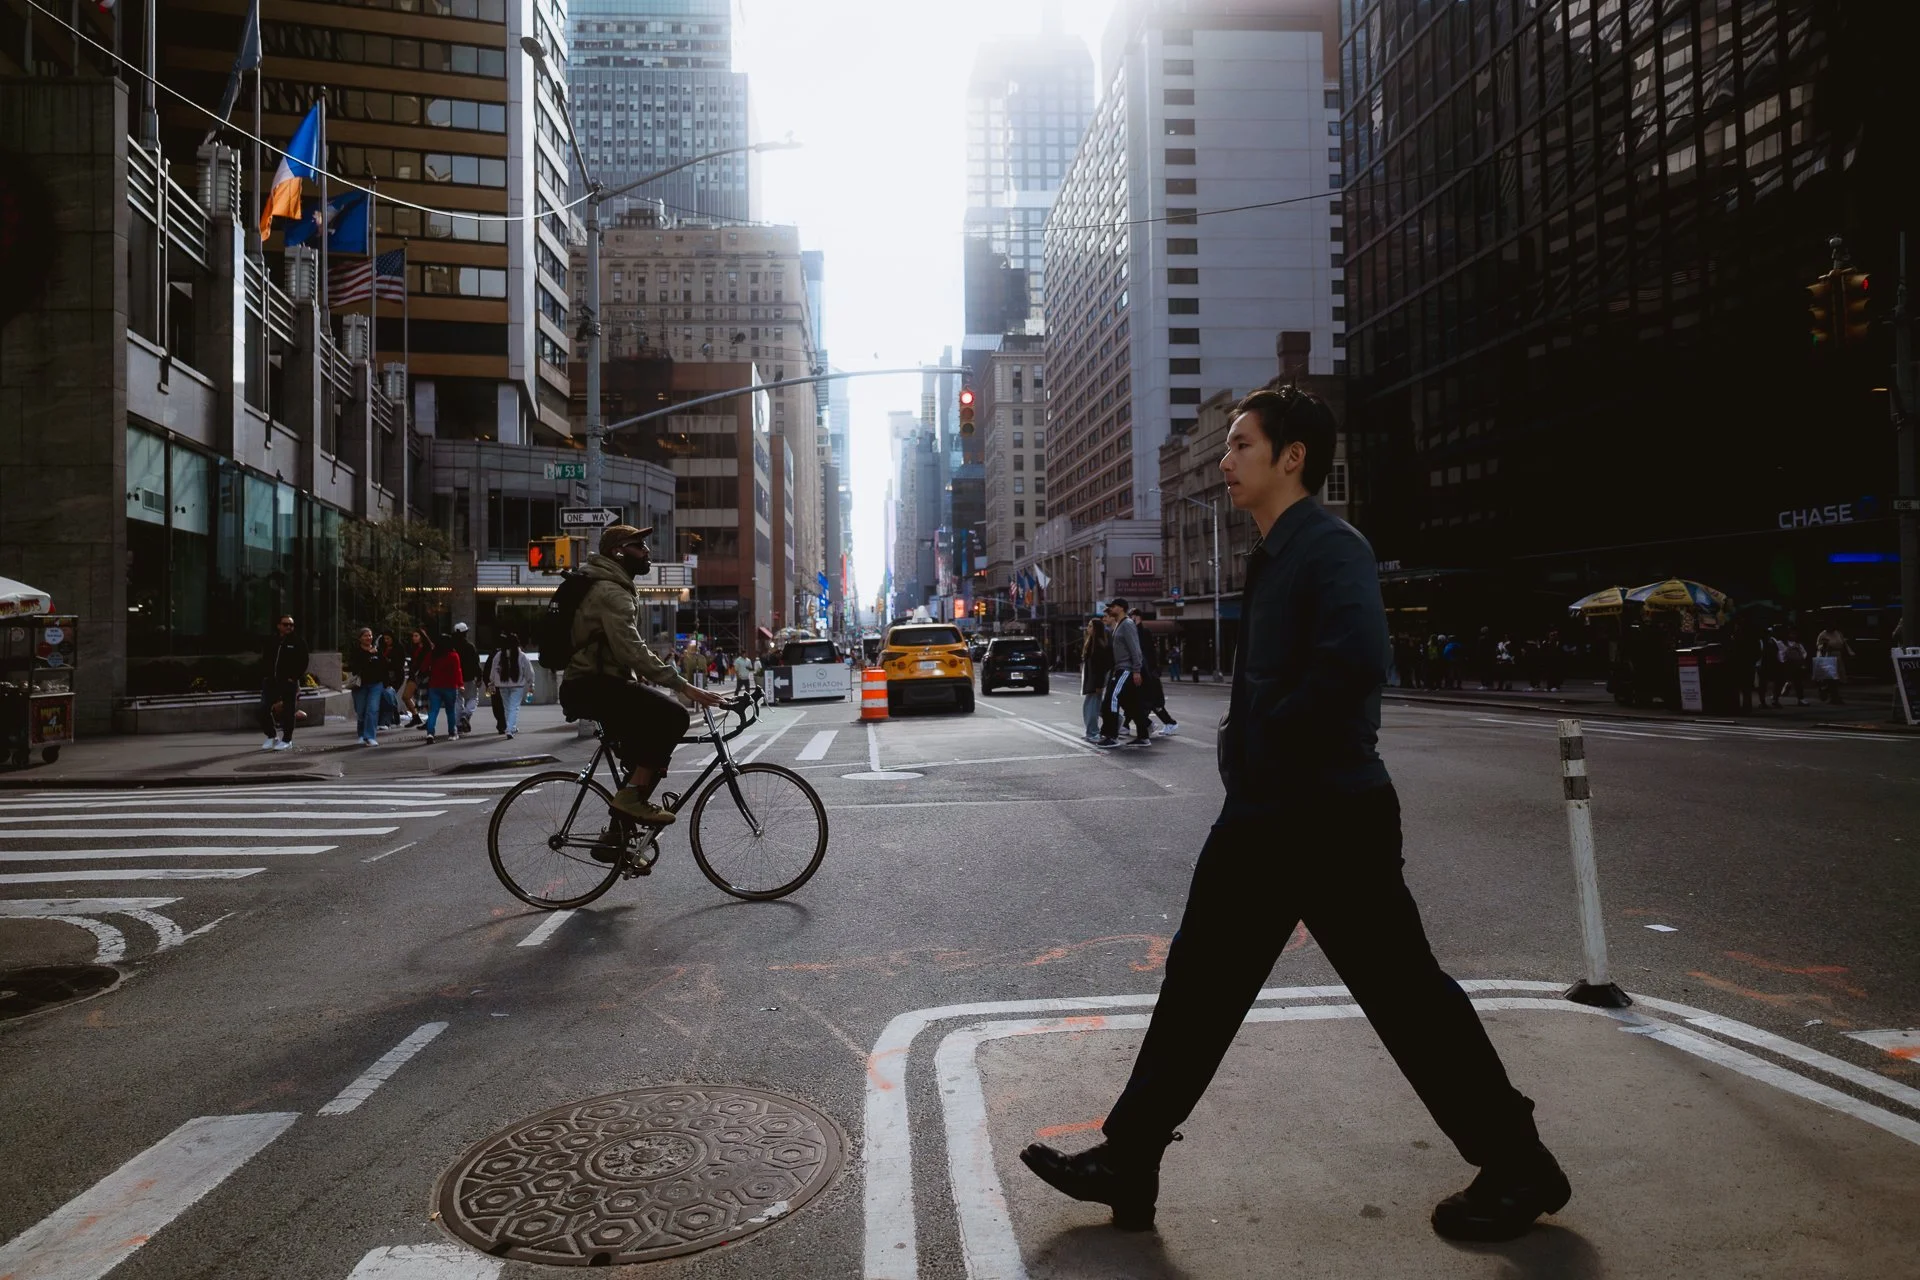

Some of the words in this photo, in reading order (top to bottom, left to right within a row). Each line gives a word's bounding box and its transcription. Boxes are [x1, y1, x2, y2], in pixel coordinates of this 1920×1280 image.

[555, 466, 562, 477] W
[565, 466, 575, 477] 53
[567, 514, 584, 522] ONE
[1778, 503, 1854, 529] CHASE
[1137, 557, 1150, 571] M
[802, 681, 843, 689] SHERATON
